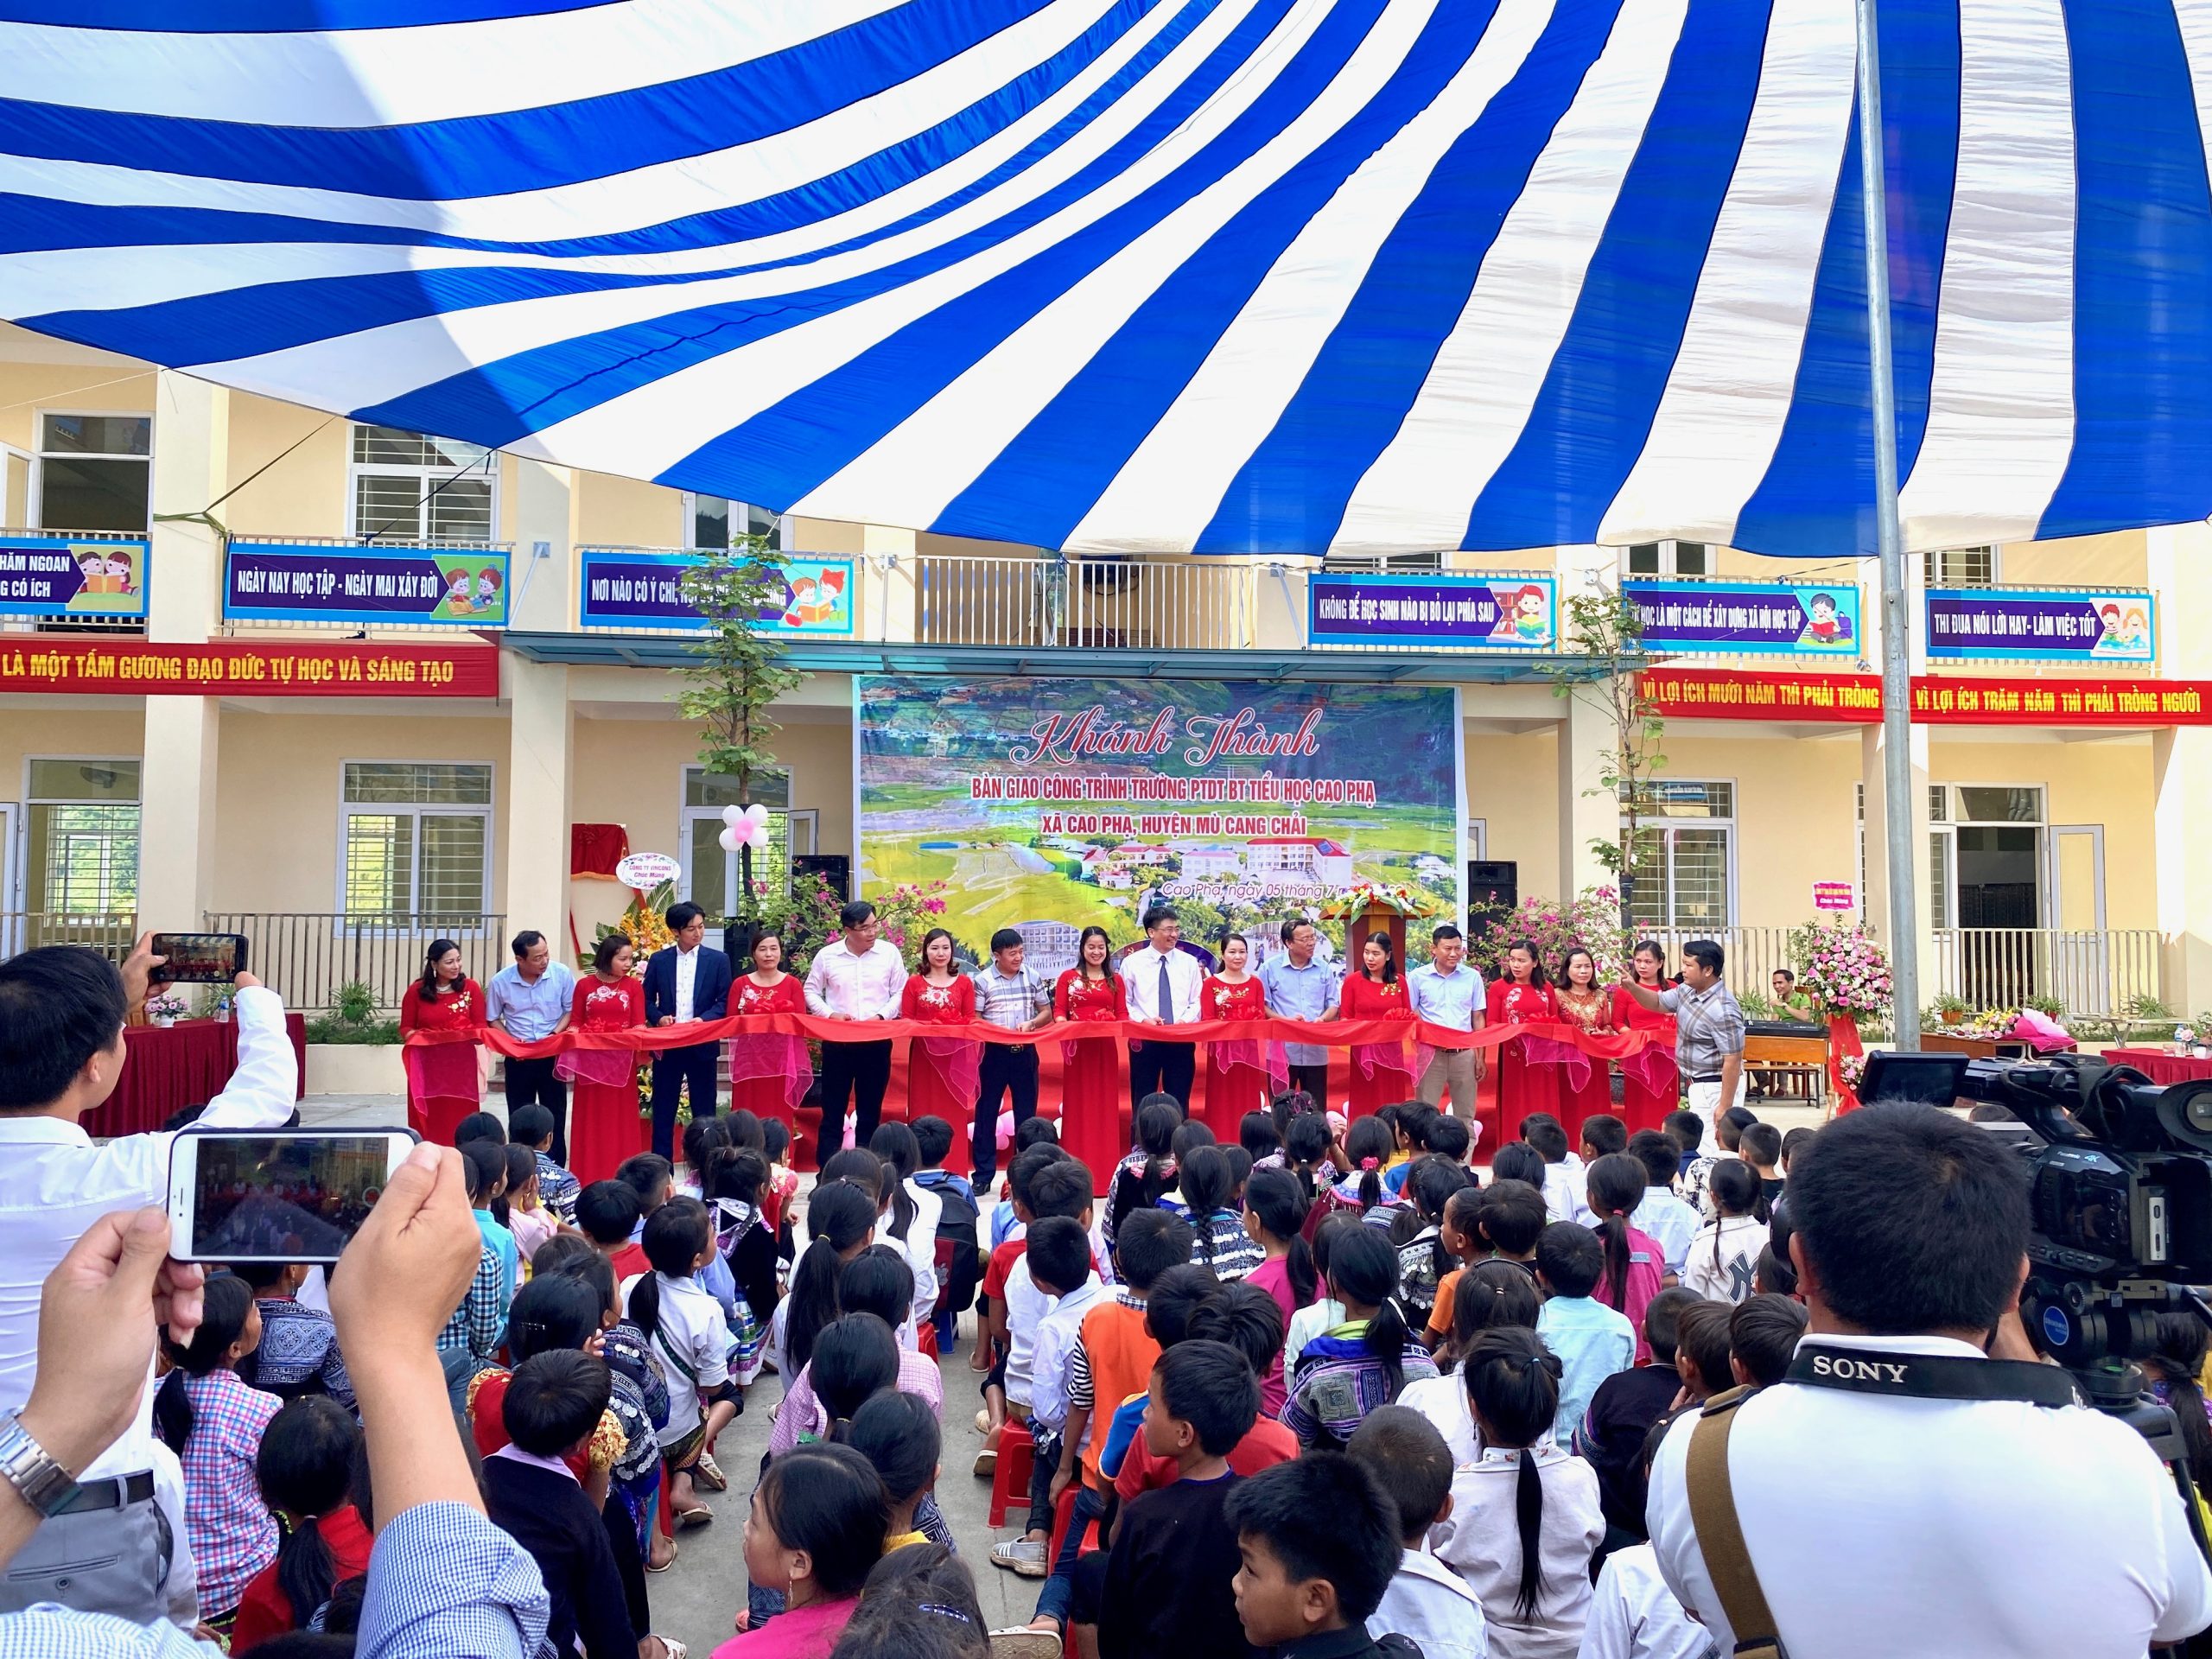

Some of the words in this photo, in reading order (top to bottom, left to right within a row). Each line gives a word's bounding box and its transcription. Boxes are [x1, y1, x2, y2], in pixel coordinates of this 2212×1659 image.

[29, 556, 70, 572] NGOAN
[11, 577, 28, 597] CÓ
[30, 577, 51, 597] ÍCH
[238, 566, 266, 593] NGÀY
[268, 571, 290, 594] NAY
[292, 572, 314, 599] HỌC
[315, 568, 336, 600] TẬP
[345, 569, 373, 596] NGÀY
[375, 575, 396, 597] MAI
[397, 571, 418, 597] XÂY
[420, 570, 438, 598] ĐỜI
[591, 577, 609, 601] NƠI
[611, 575, 632, 601] NÀO
[634, 575, 648, 602] CÓ
[650, 576, 657, 602] Ý
[658, 576, 678, 606] CHÍ,
[1319, 594, 1347, 620] KHÔNG
[1348, 590, 1360, 620] ĐỂ
[1361, 599, 1378, 625] HỌC
[1379, 600, 1399, 621] SINH
[1401, 595, 1418, 621] NÀO
[1419, 601, 1428, 626] BỊ
[1429, 592, 1441, 621] BỎ
[1442, 601, 1456, 626] LẠI
[1457, 597, 1477, 622] PHÍA
[1478, 601, 1495, 623] SAU
[1641, 606, 1656, 631] HỌC
[1656, 601, 1666, 626] LÀ
[1666, 601, 1682, 632] MỘT
[1682, 602, 1702, 627] CÁCH
[1702, 599, 1713, 627] ĐỂ
[1713, 603, 1727, 628] XÂY
[1728, 606, 1748, 632] DỰNG
[1748, 604, 1758, 629] XÃ
[1759, 604, 1771, 633] HỘI
[1772, 608, 1787, 633] HỌC
[1787, 605, 1801, 634] TẬP
[1934, 613, 1949, 633] THI
[1951, 613, 1971, 634] ĐUA
[1973, 610, 1990, 635] NÓI
[1992, 609, 2007, 635] LỜI
[2033, 611, 2054, 636] LÀM
[2056, 612, 2077, 641] VIỆC
[2078, 610, 2096, 637] TỐT
[2, 649, 25, 677] LÀ
[30, 650, 71, 682] MỘT
[75, 648, 115, 678] TẤM
[119, 654, 181, 680] GƯƠNG
[187, 657, 224, 684] ĐẠO
[228, 652, 265, 680] ĐỨC
[270, 656, 296, 684] TỰ
[297, 658, 334, 684] HỌC
[338, 655, 362, 681] VÀ
[366, 655, 415, 682] SÁNG
[420, 660, 454, 687] TẠO
[1643, 677, 1656, 698] VÌ
[1659, 680, 1681, 706] LỢI
[1683, 678, 1706, 702] ÍCH
[1708, 678, 1743, 704] MƯỜI
[1745, 680, 1776, 704] NĂM
[1779, 682, 1800, 705] THÌ
[1802, 679, 1834, 707] PHẢI
[1837, 679, 1879, 709] TRỒNG
[1916, 685, 1929, 710] VÌ
[1932, 689, 1953, 714] LỢI
[1957, 685, 1979, 710] ÍCH
[1983, 687, 2019, 711] TRĂM
[2024, 688, 2055, 712] NĂM
[2061, 688, 2082, 712] THÌ
[2084, 684, 2114, 713] PHẢI
[2117, 684, 2158, 713] TRỒNG
[2162, 687, 2201, 713] NGƯỜI
[1008, 704, 1176, 766] Khánh
[1184, 707, 1325, 766] Thành
[971, 774, 1002, 799] BÀN
[1006, 777, 1039, 799] GIAO
[1042, 774, 1082, 800] CÔNG
[1085, 774, 1128, 800] TRÌNH
[1131, 774, 1186, 800] TRƯỜNG
[1191, 779, 1225, 801] PTDT
[1229, 779, 1246, 801] BT
[1249, 772, 1280, 802] TIỂU
[1284, 780, 1313, 805] HỌC
[1314, 780, 1343, 803] CAO
[1346, 781, 1376, 808] PHẠ
[1042, 812, 1063, 834] XÃ
[1067, 816, 1097, 834] CAO
[1102, 816, 1137, 838] PHẠ,
[1141, 812, 1191, 838] HUYỆN
[1196, 813, 1220, 835] MÙ
[1224, 817, 1266, 835] CANG
[1271, 812, 1307, 836] CHẢI
[1162, 882, 1193, 897] Cao
[1228, 883, 1263, 900] ngày
[1265, 885, 1281, 897] 05
[1284, 883, 1323, 900] tháng
[1326, 884, 1336, 899] 7
[1813, 1355, 1909, 1383] SONY
